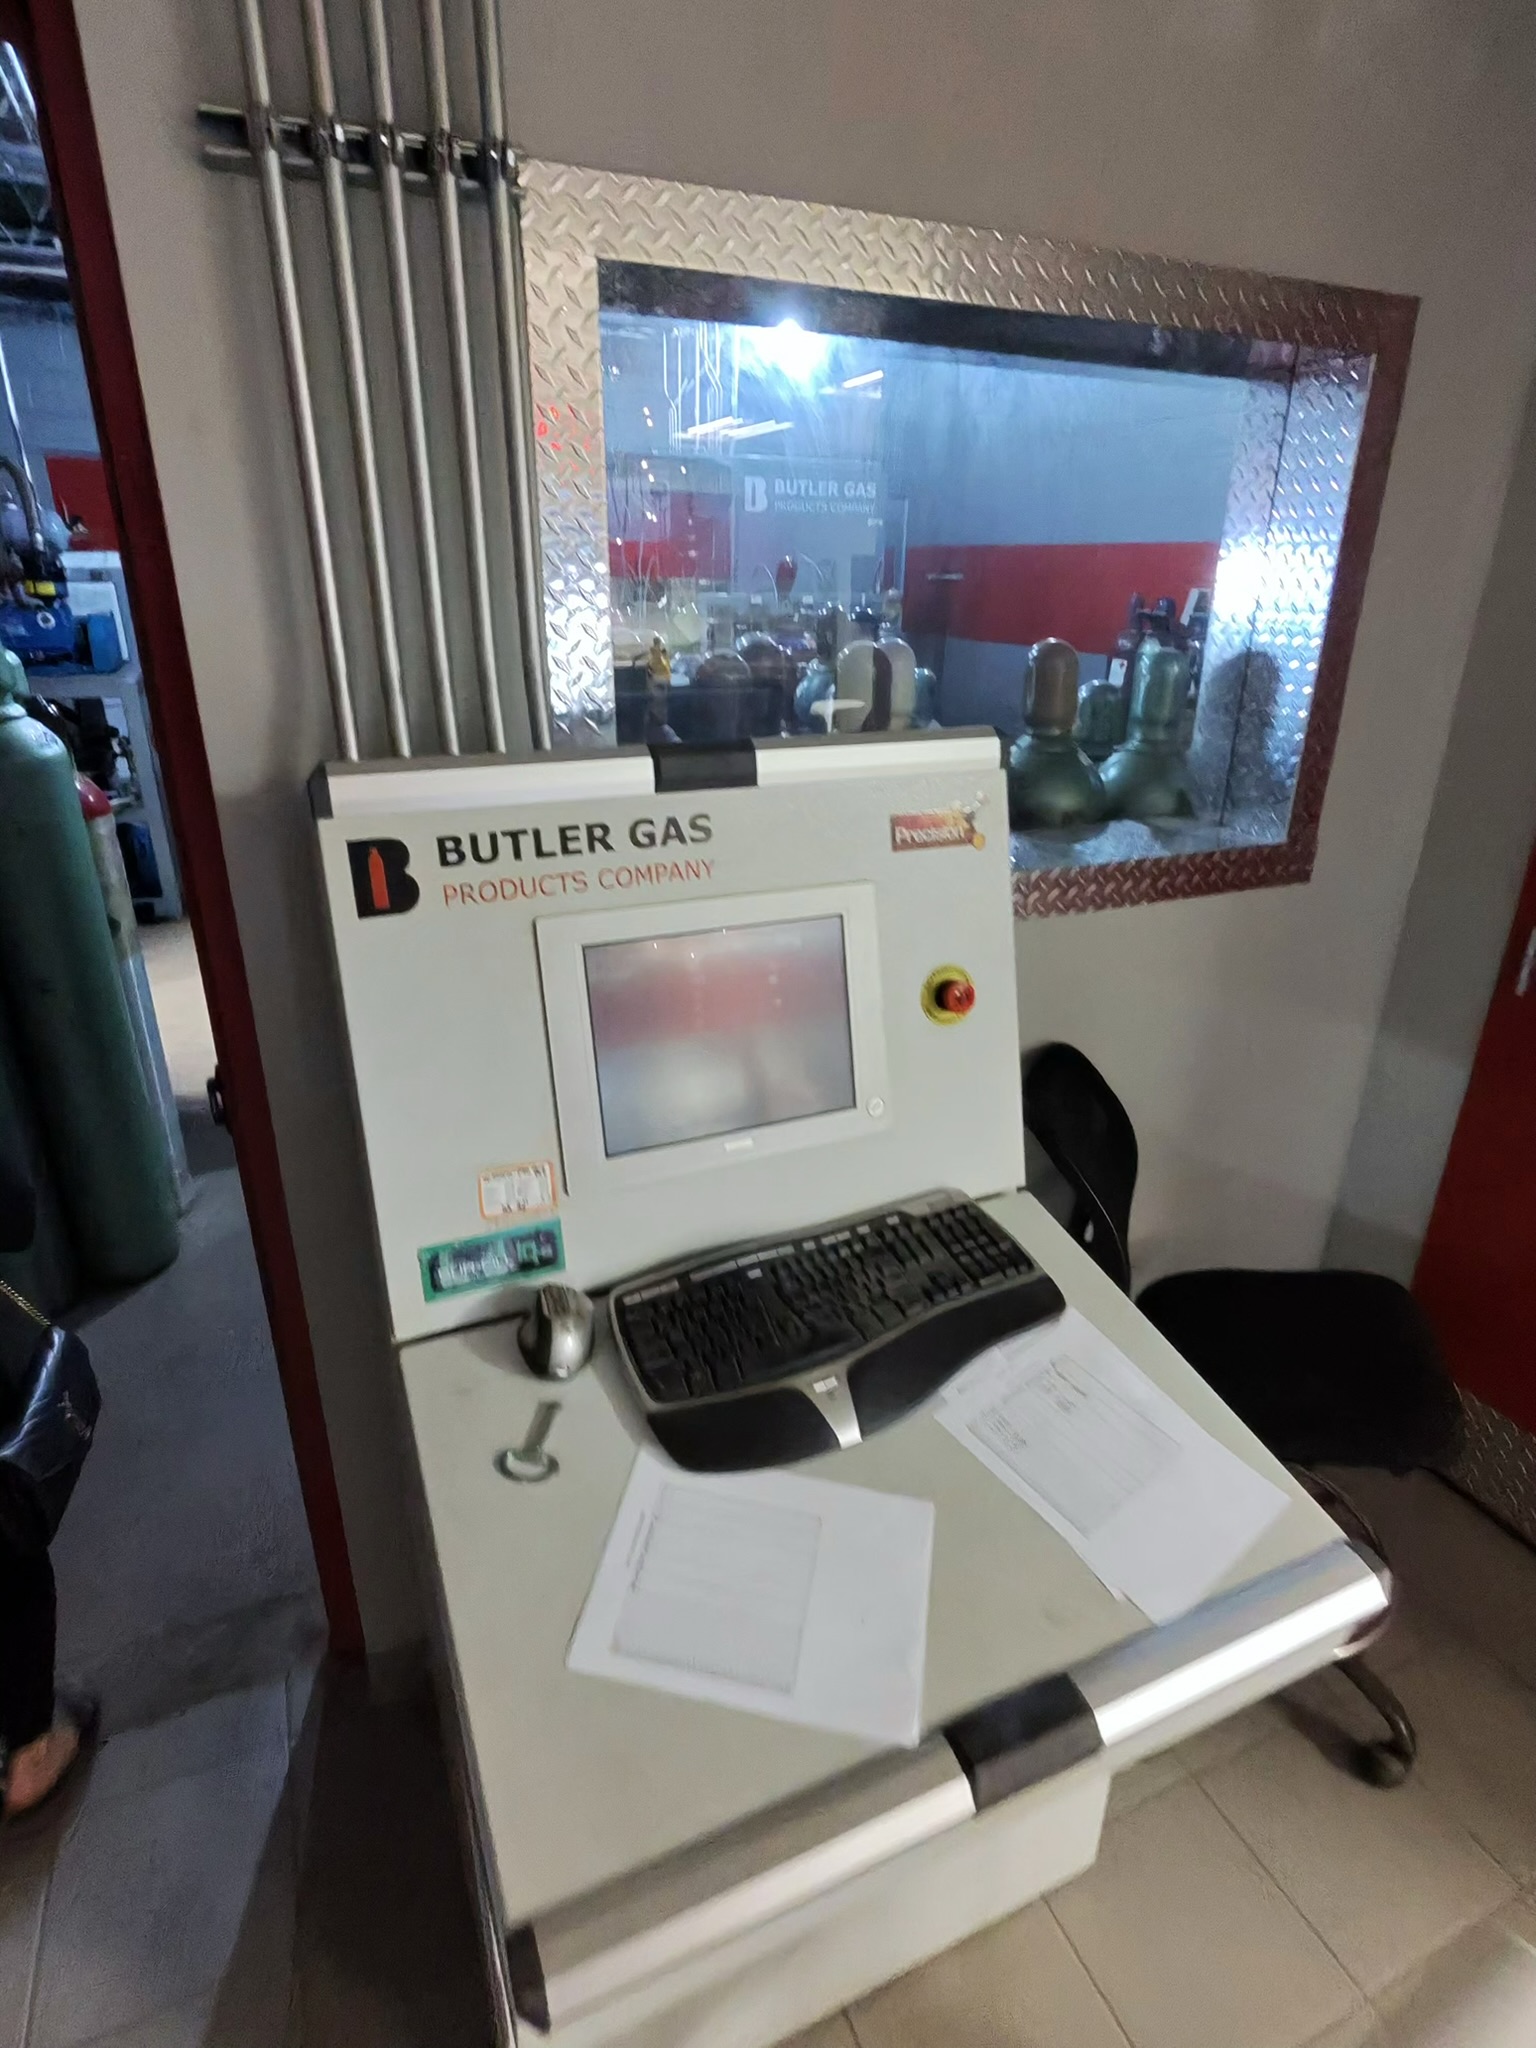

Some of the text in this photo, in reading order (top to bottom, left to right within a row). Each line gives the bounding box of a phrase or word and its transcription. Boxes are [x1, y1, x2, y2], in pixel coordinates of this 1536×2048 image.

[774, 478, 877, 499] BUTLER GAS
[436, 812, 713, 868] BUTLER GAS
[443, 858, 716, 908] PRODUCTS COMPANY
